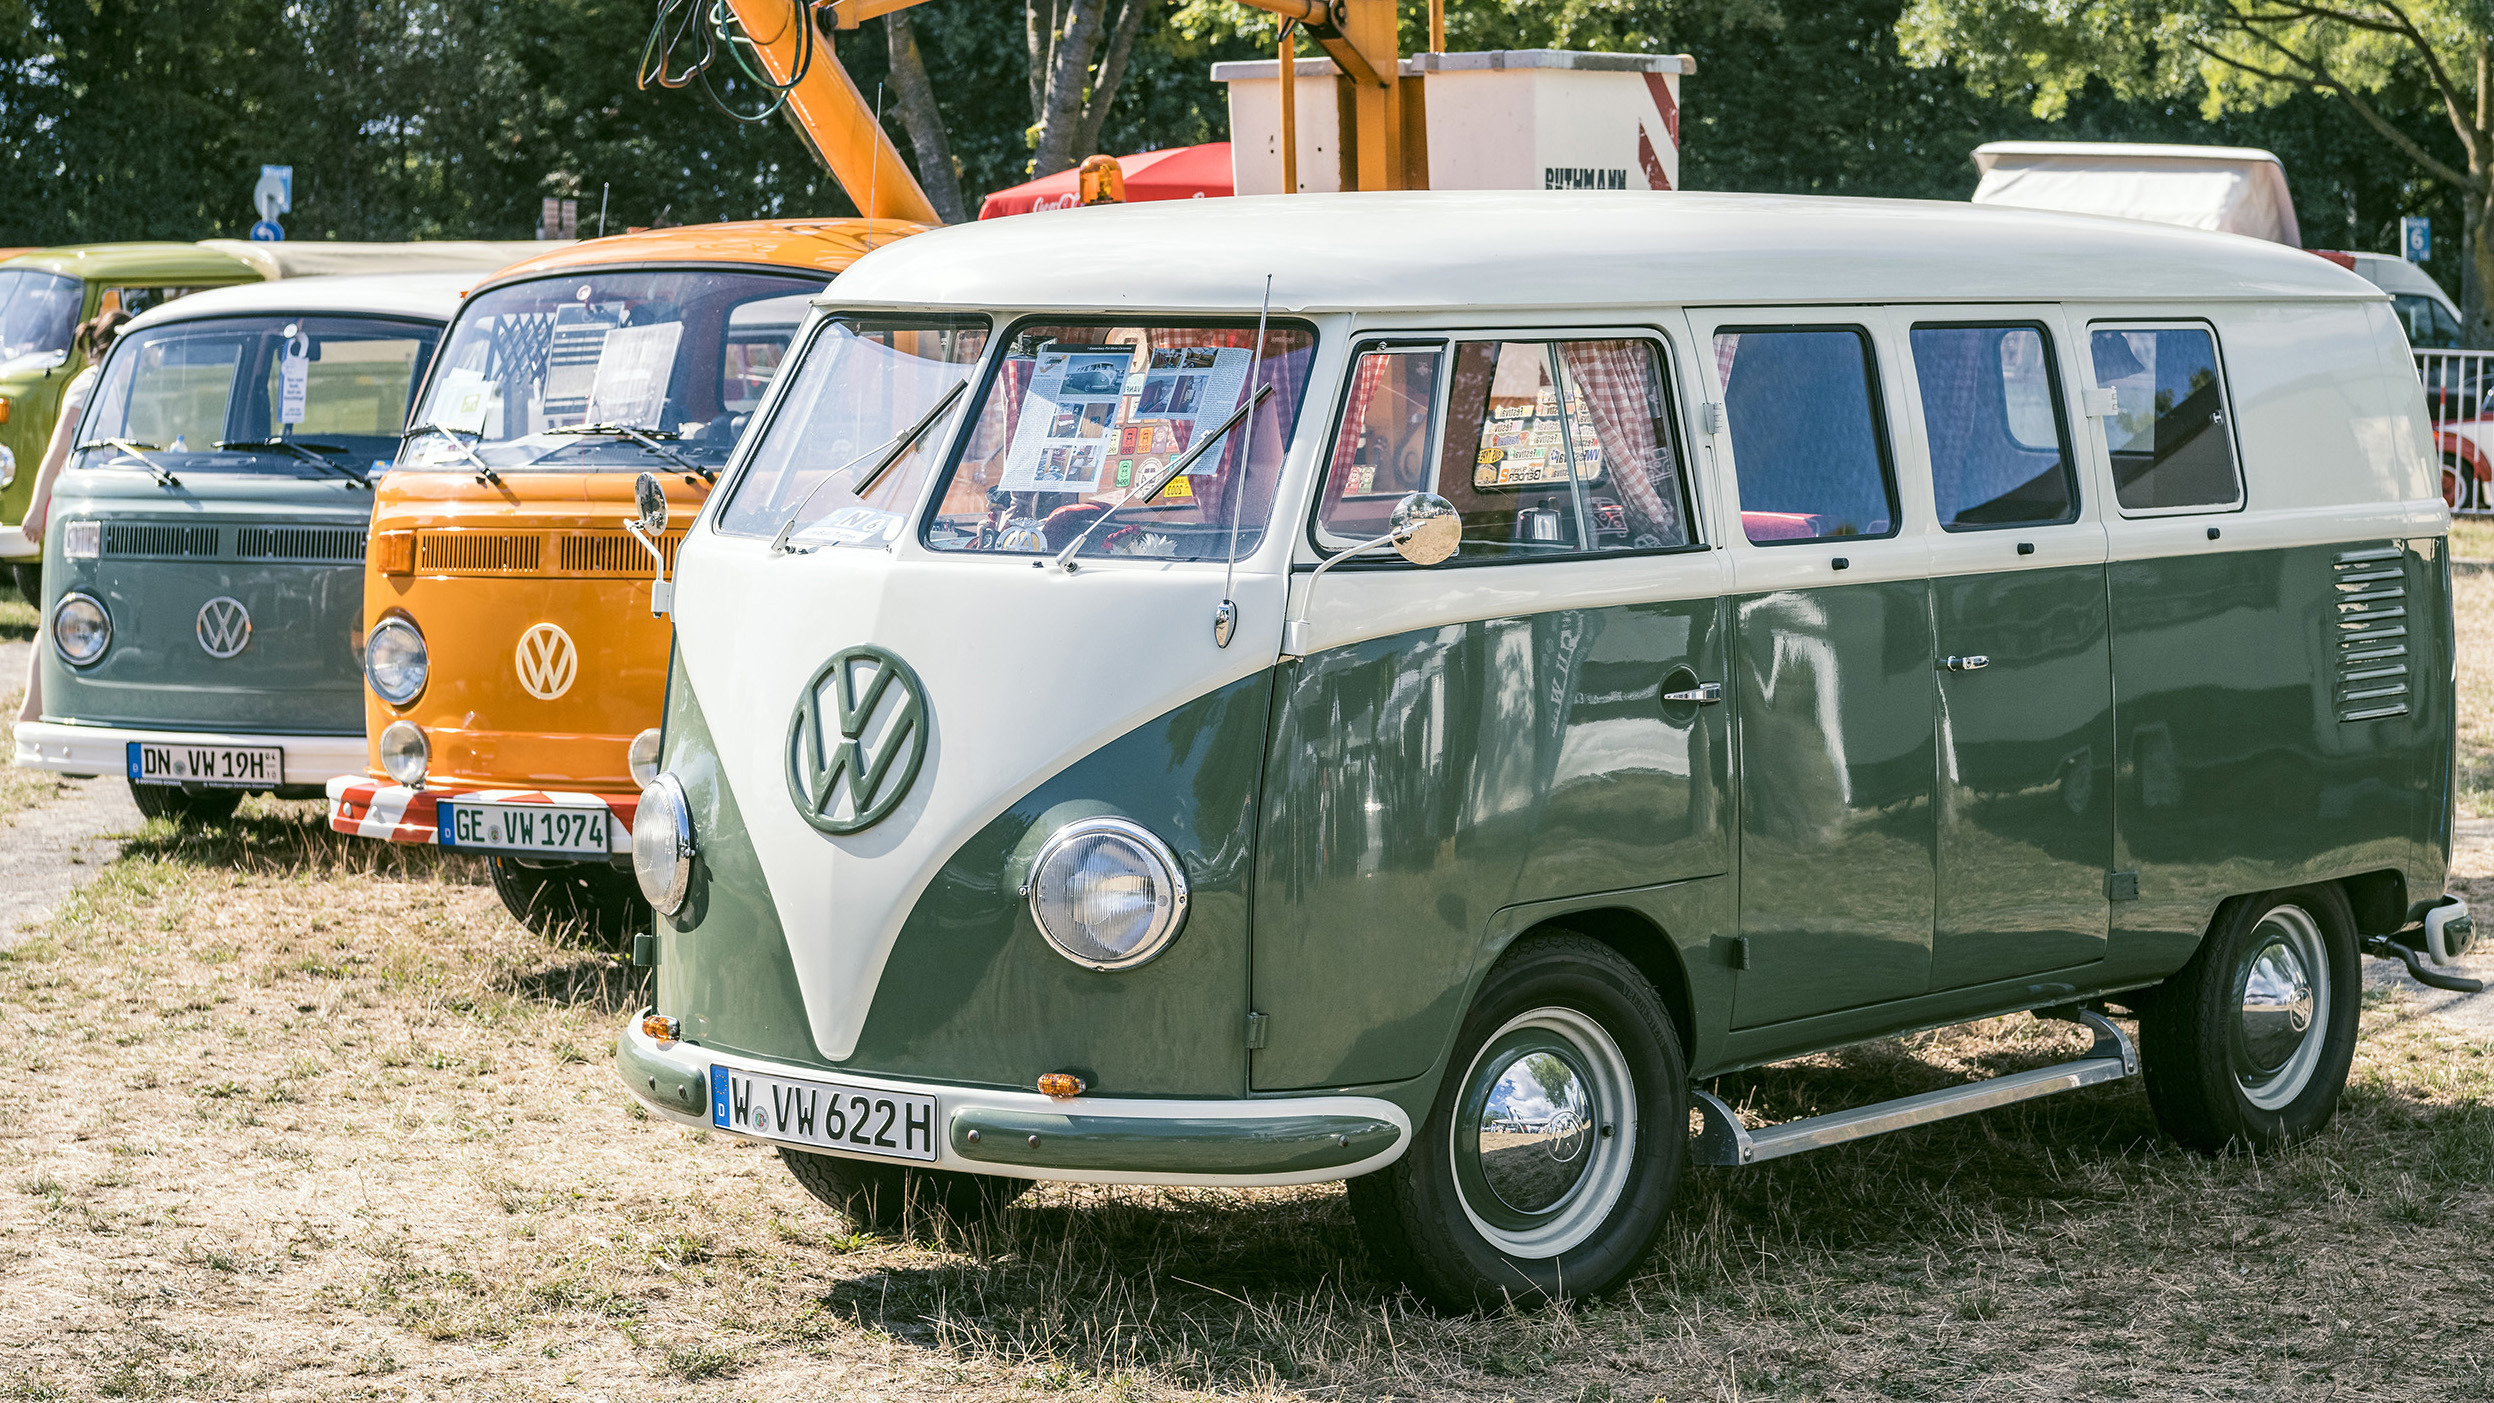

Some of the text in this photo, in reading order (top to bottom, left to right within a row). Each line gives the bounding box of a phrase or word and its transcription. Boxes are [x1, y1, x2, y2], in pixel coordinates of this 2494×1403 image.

[2410, 227, 2424, 250] 6
[197, 596, 250, 658] VW
[516, 623, 577, 700] VW
[143, 749, 171, 775] DN
[188, 750, 215, 776] VW
[785, 643, 929, 835] VW
[456, 809, 604, 848] GE VW 1974
[718, 1103, 725, 1117] D
[732, 1076, 751, 1126] W
[772, 1085, 817, 1136] VW
